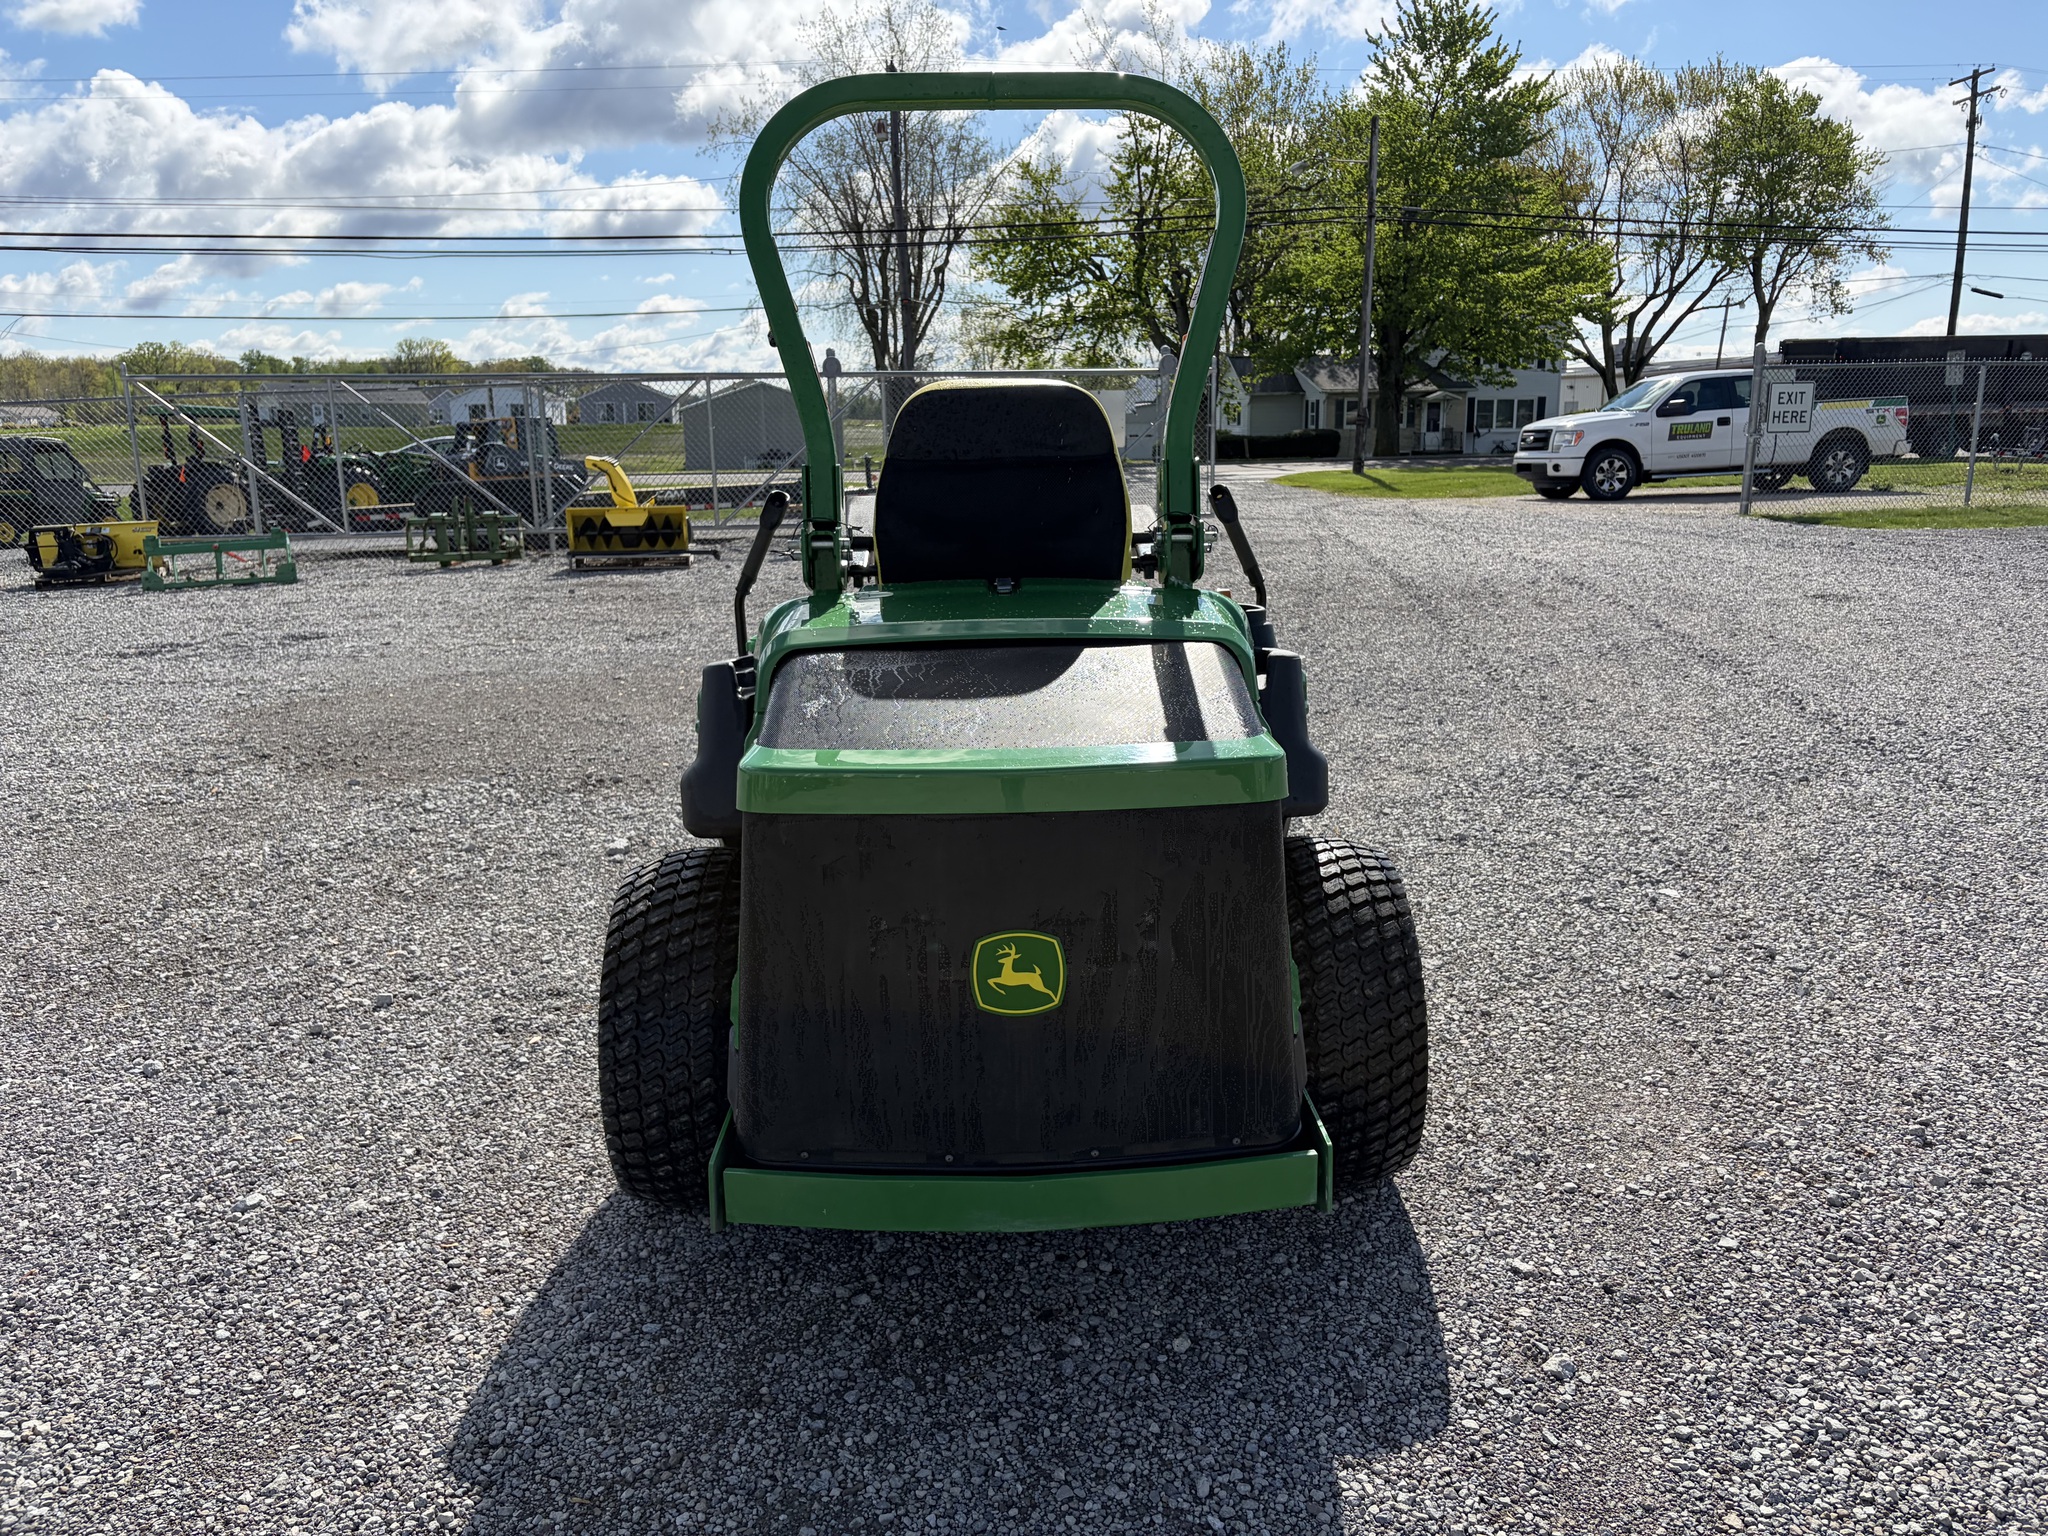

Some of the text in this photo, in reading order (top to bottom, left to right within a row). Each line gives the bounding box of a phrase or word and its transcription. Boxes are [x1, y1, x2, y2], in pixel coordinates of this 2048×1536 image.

[1778, 391, 1806, 405] EXIT
[1772, 410, 1807, 424] HERE
[1671, 422, 1712, 435] TRULAND
[553, 462, 574, 471] DEERE
